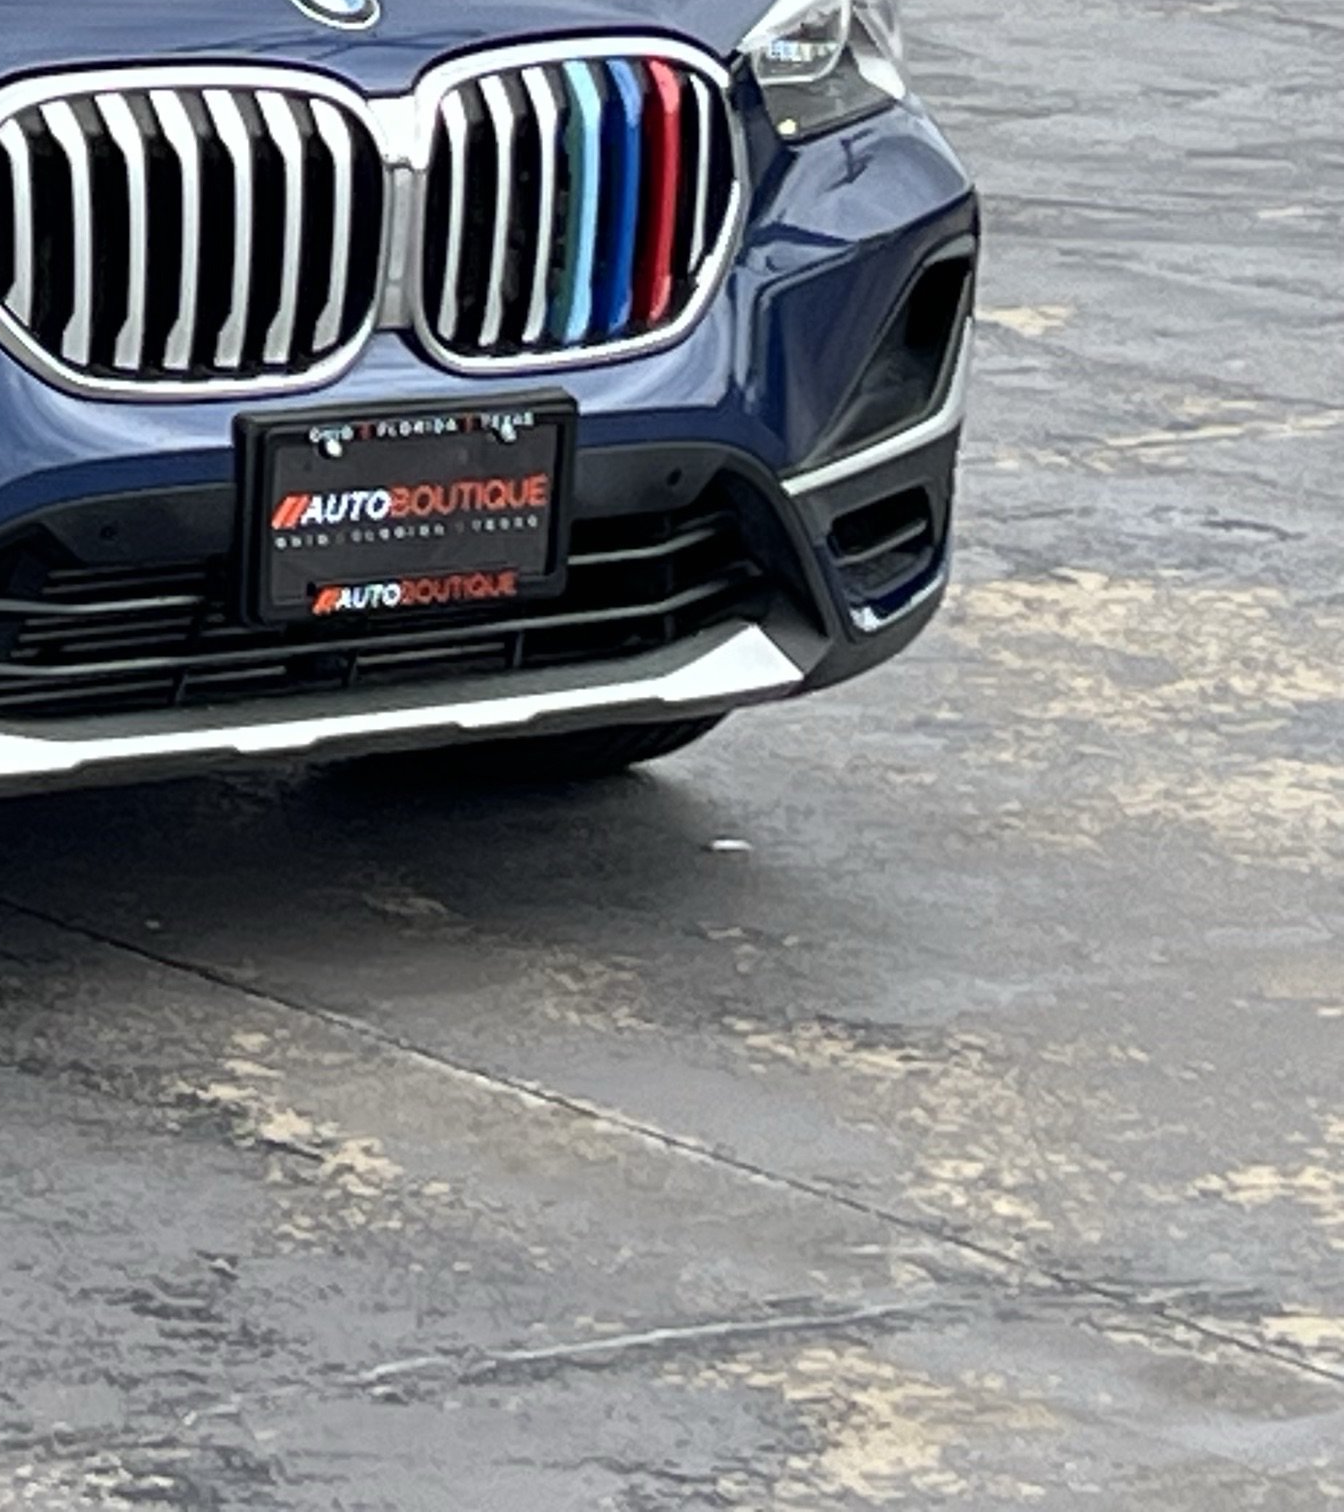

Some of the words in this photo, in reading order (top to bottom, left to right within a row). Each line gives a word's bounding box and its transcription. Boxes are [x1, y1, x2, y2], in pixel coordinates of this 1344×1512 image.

[376, 417, 457, 437] FLORIDA
[480, 410, 534, 431] TEXAS
[300, 473, 547, 524] AUTOBOUTIQUE
